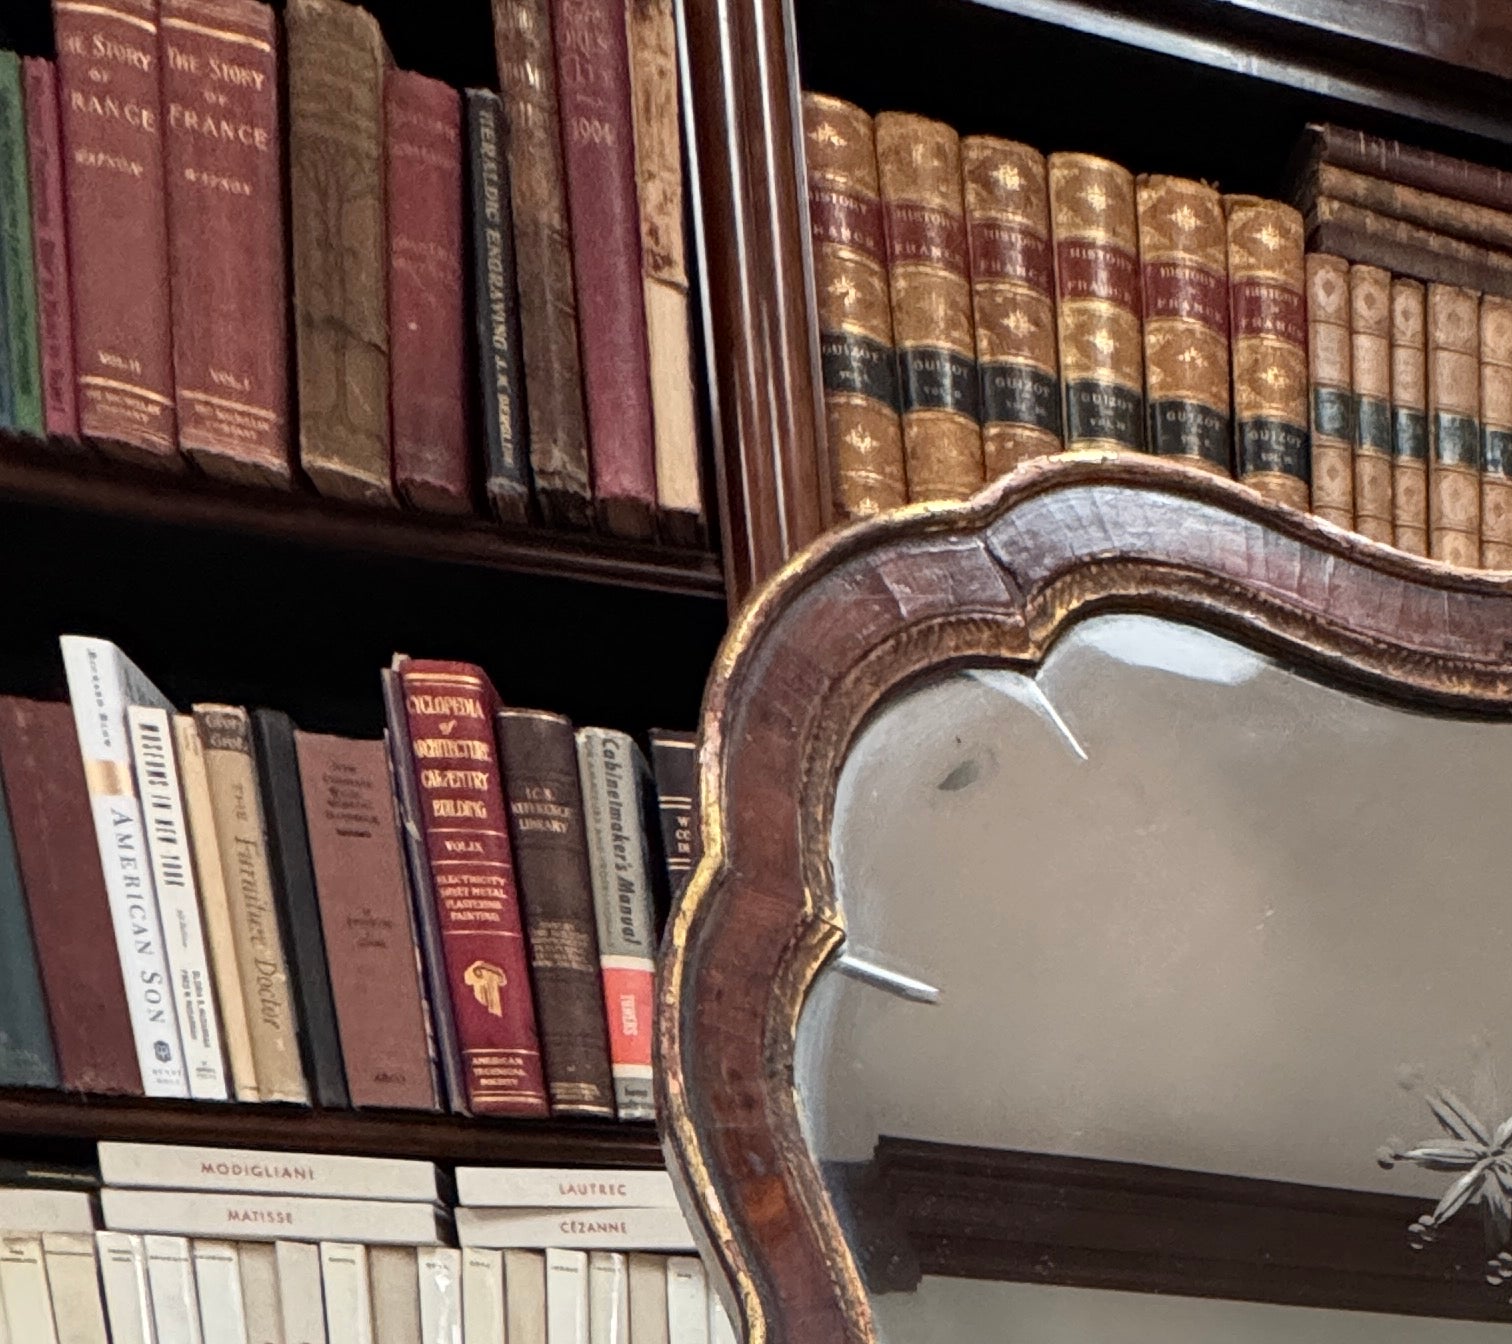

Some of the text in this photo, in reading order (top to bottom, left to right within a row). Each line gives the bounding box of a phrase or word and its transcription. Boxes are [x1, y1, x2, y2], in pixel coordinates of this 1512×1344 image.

[207, 55, 265, 91] STORY
[70, 90, 156, 133] RANCE
[167, 103, 270, 151] FRANCE
[407, 695, 485, 720] CYCLOPEDIA
[420, 769, 489, 791] CARPENTRY
[602, 738, 642, 946] Cabinetmaker's Manual
[111, 807, 166, 1024] AMERICAN SON
[234, 835, 272, 947] Furniture
[254, 956, 283, 1030] Doctor
[201, 1163, 315, 1181] MODIGLIANI
[558, 1183, 627, 1197] LAUTREC
[228, 1209, 293, 1225] MATISSE
